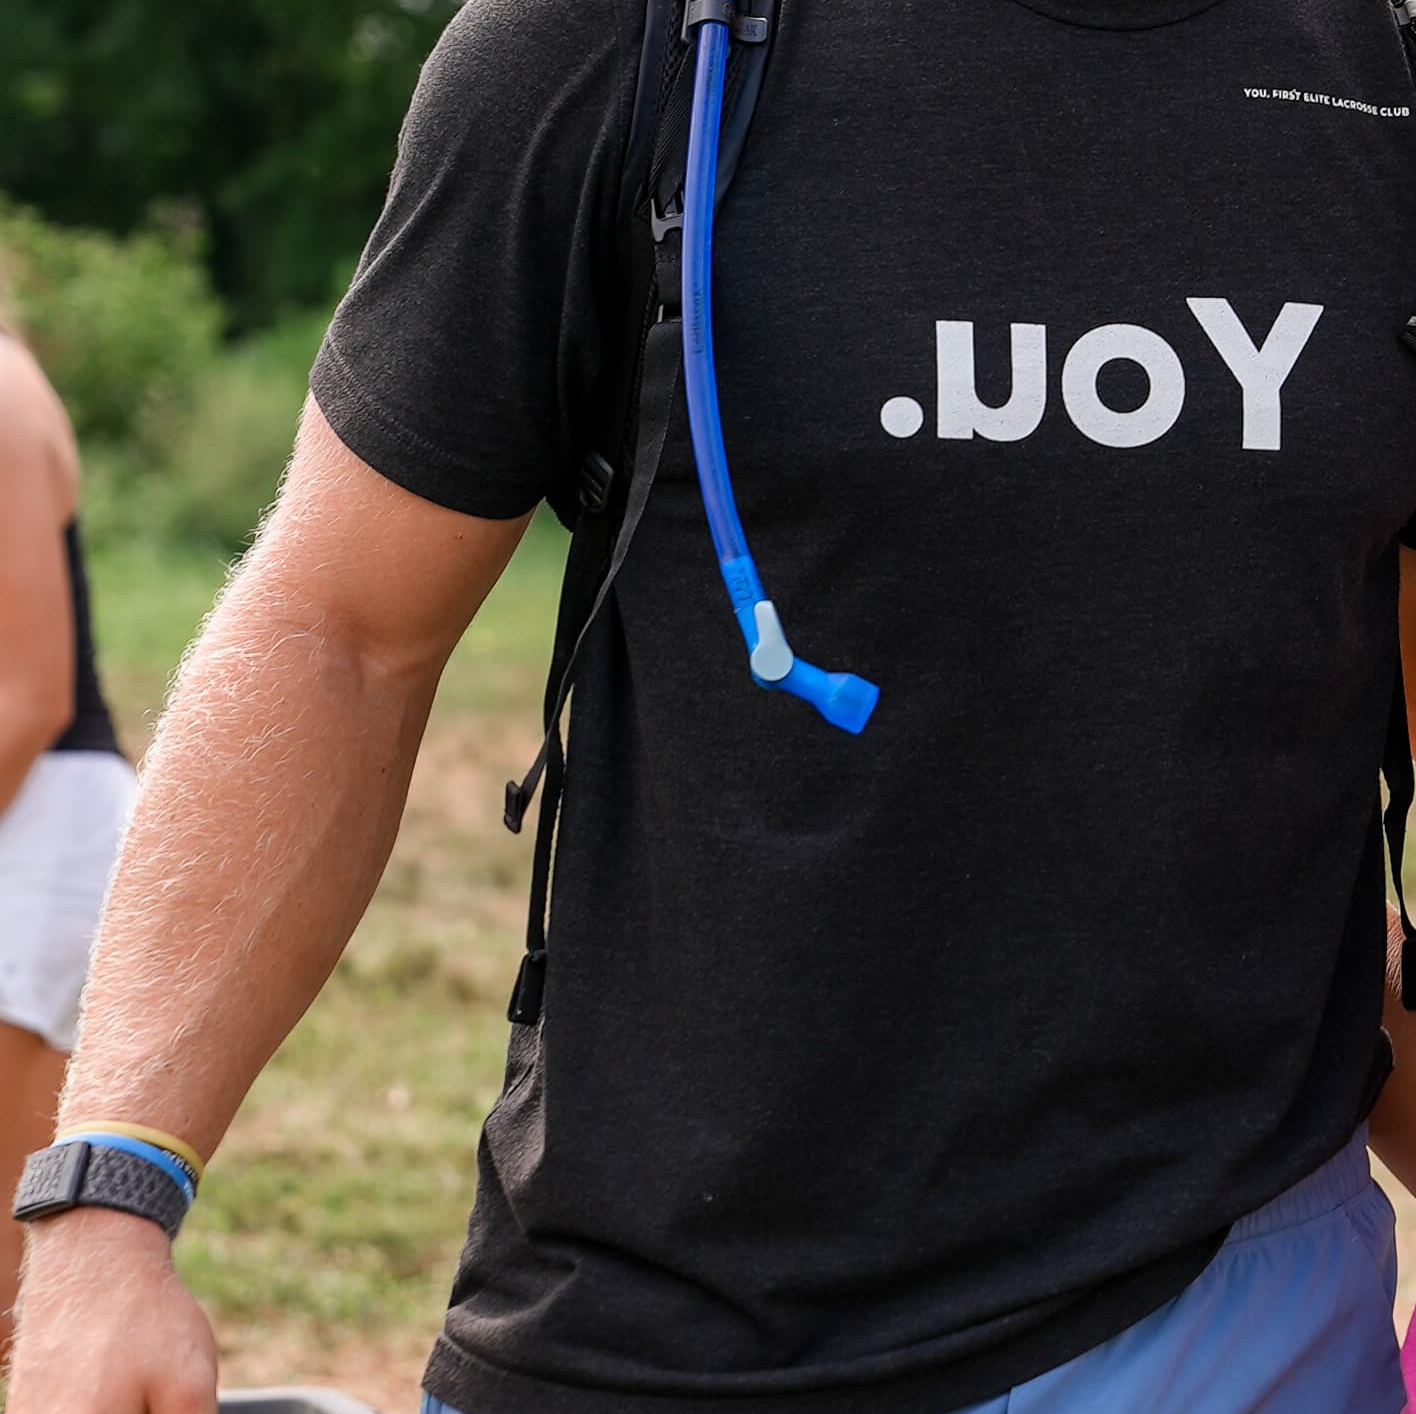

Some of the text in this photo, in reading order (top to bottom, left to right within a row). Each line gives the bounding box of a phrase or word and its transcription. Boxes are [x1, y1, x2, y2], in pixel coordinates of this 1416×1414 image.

[1243, 88, 1410, 117] YOU. FIRST ELITE LACROSSE CLUB
